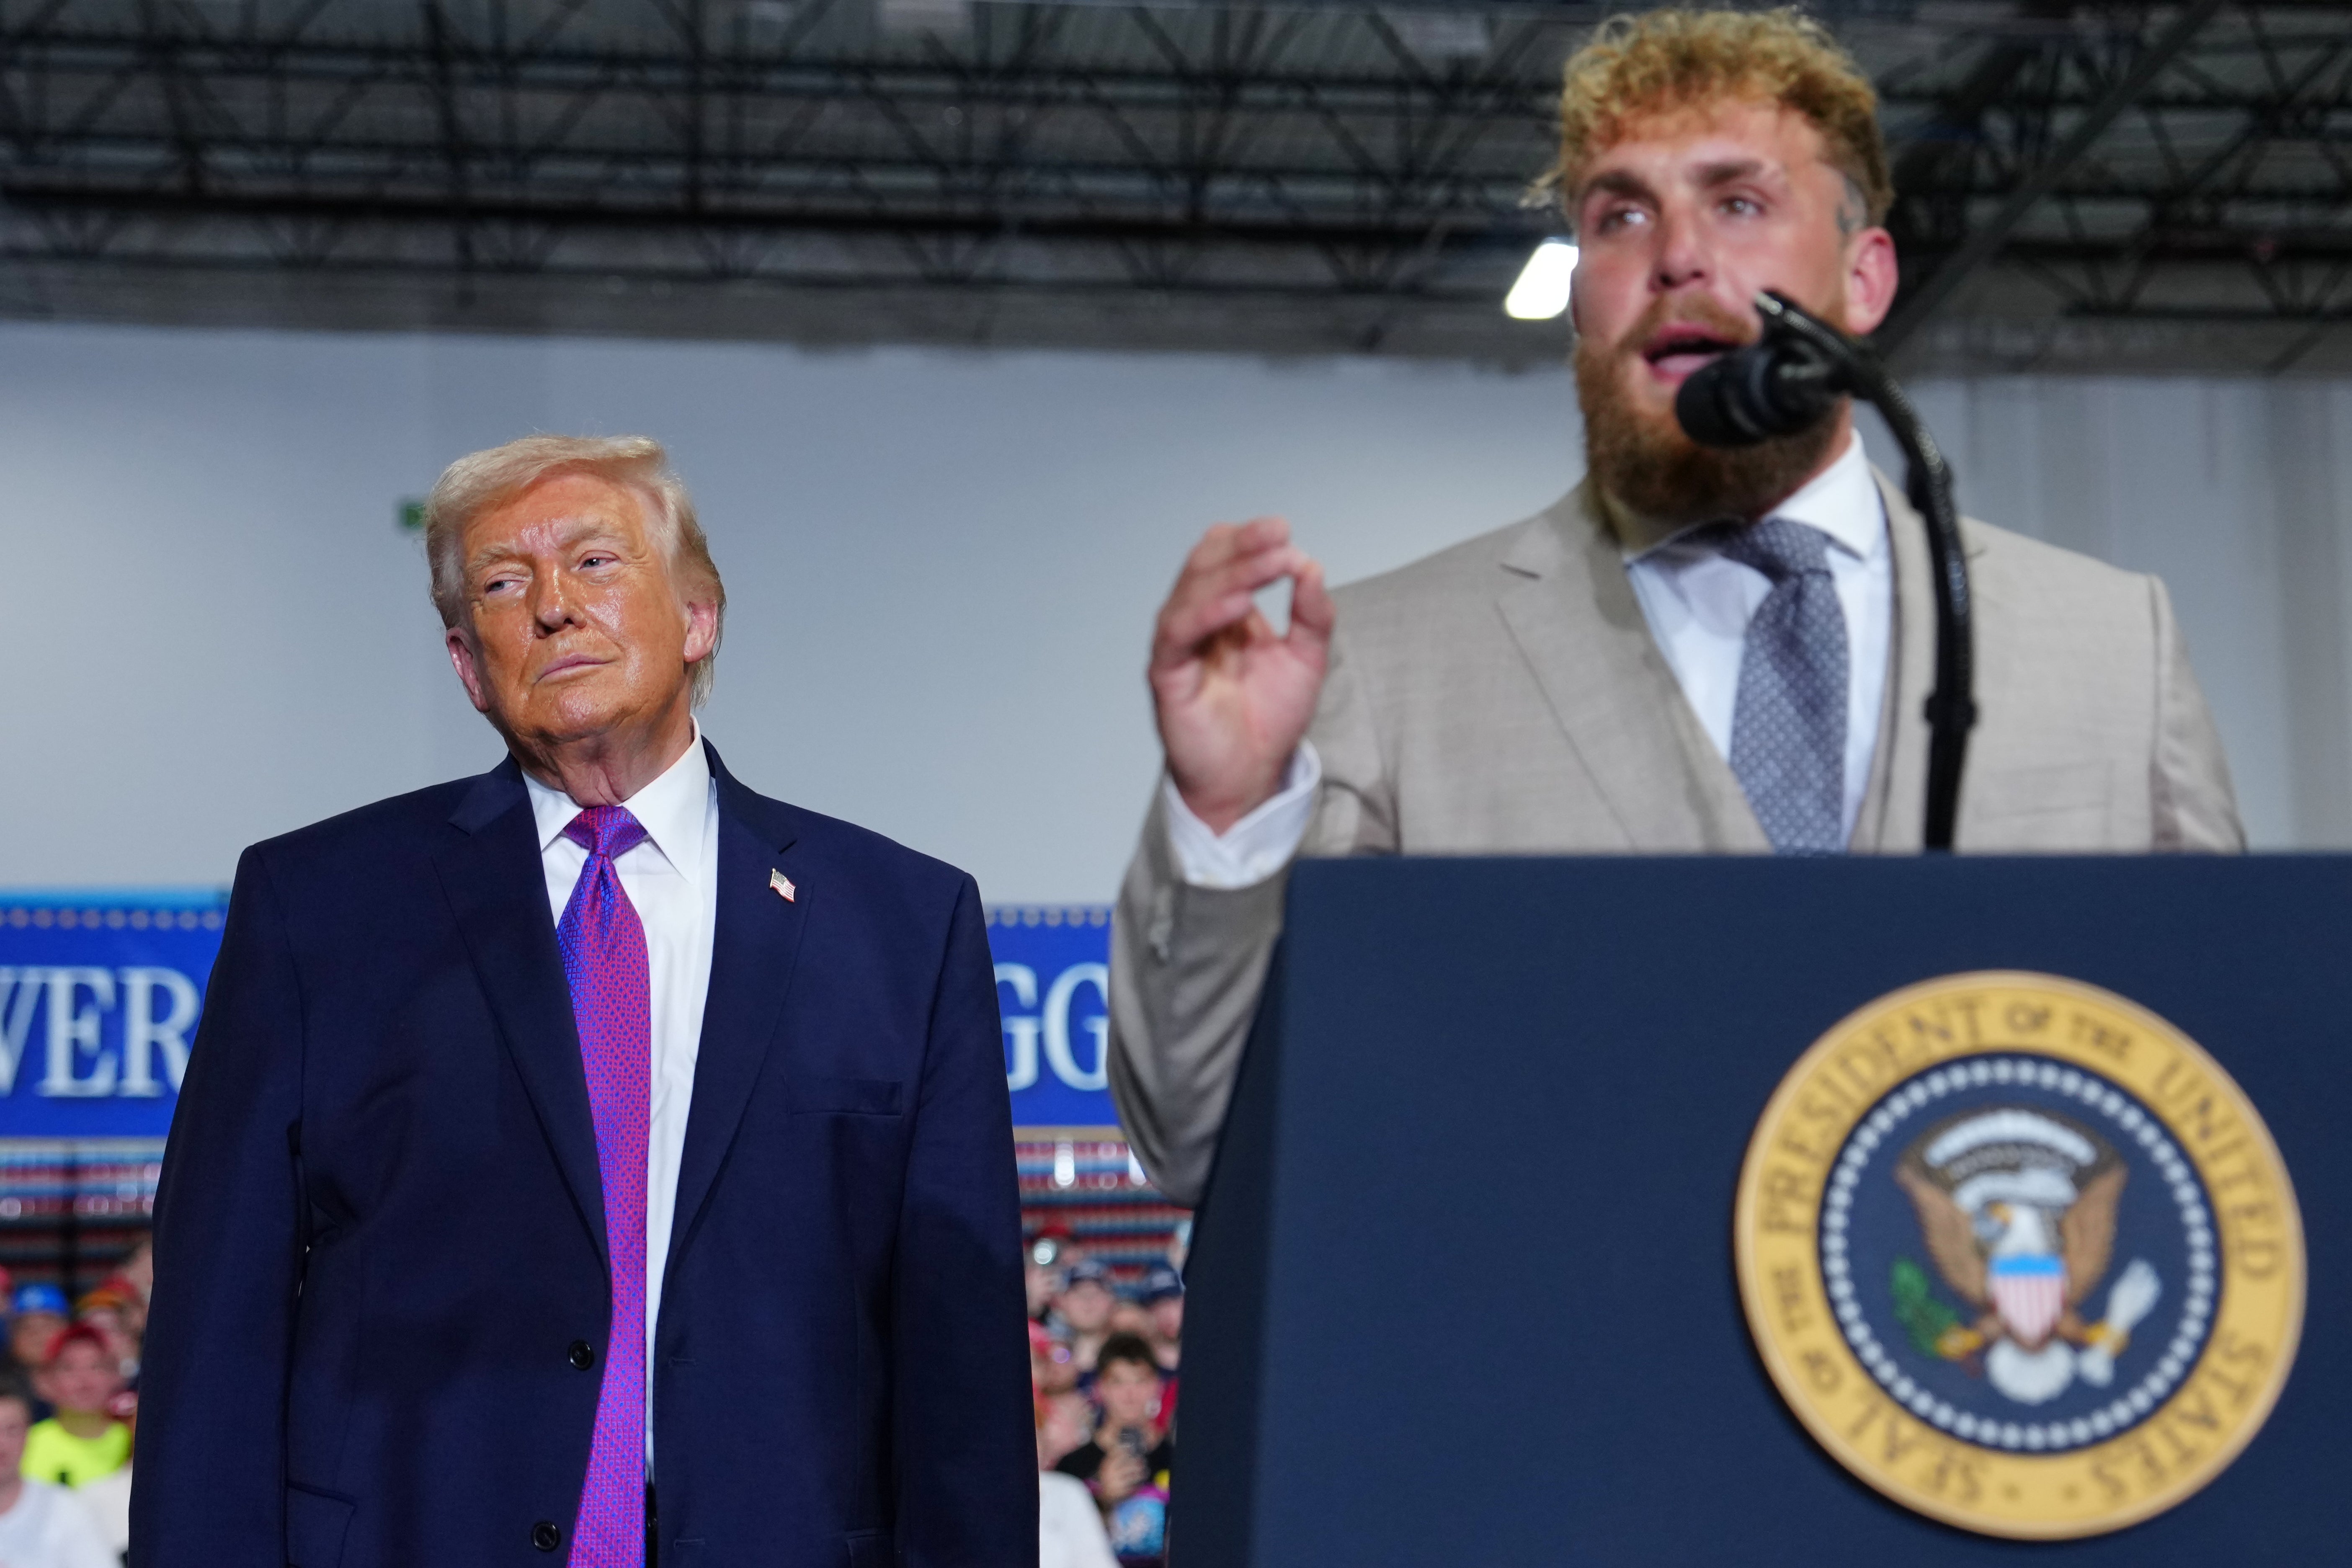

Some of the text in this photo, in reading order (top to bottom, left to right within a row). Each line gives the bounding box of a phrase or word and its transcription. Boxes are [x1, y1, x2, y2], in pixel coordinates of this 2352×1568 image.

[2003, 1001, 2053, 1034] OF
[1762, 997, 1986, 1234] PRESIDENT
[2152, 1055, 2282, 1281] UNITED
[1801, 1348, 1842, 1397] OF
[2090, 1329, 2270, 1504] STATES
[1849, 1388, 1988, 1504] SEAL
